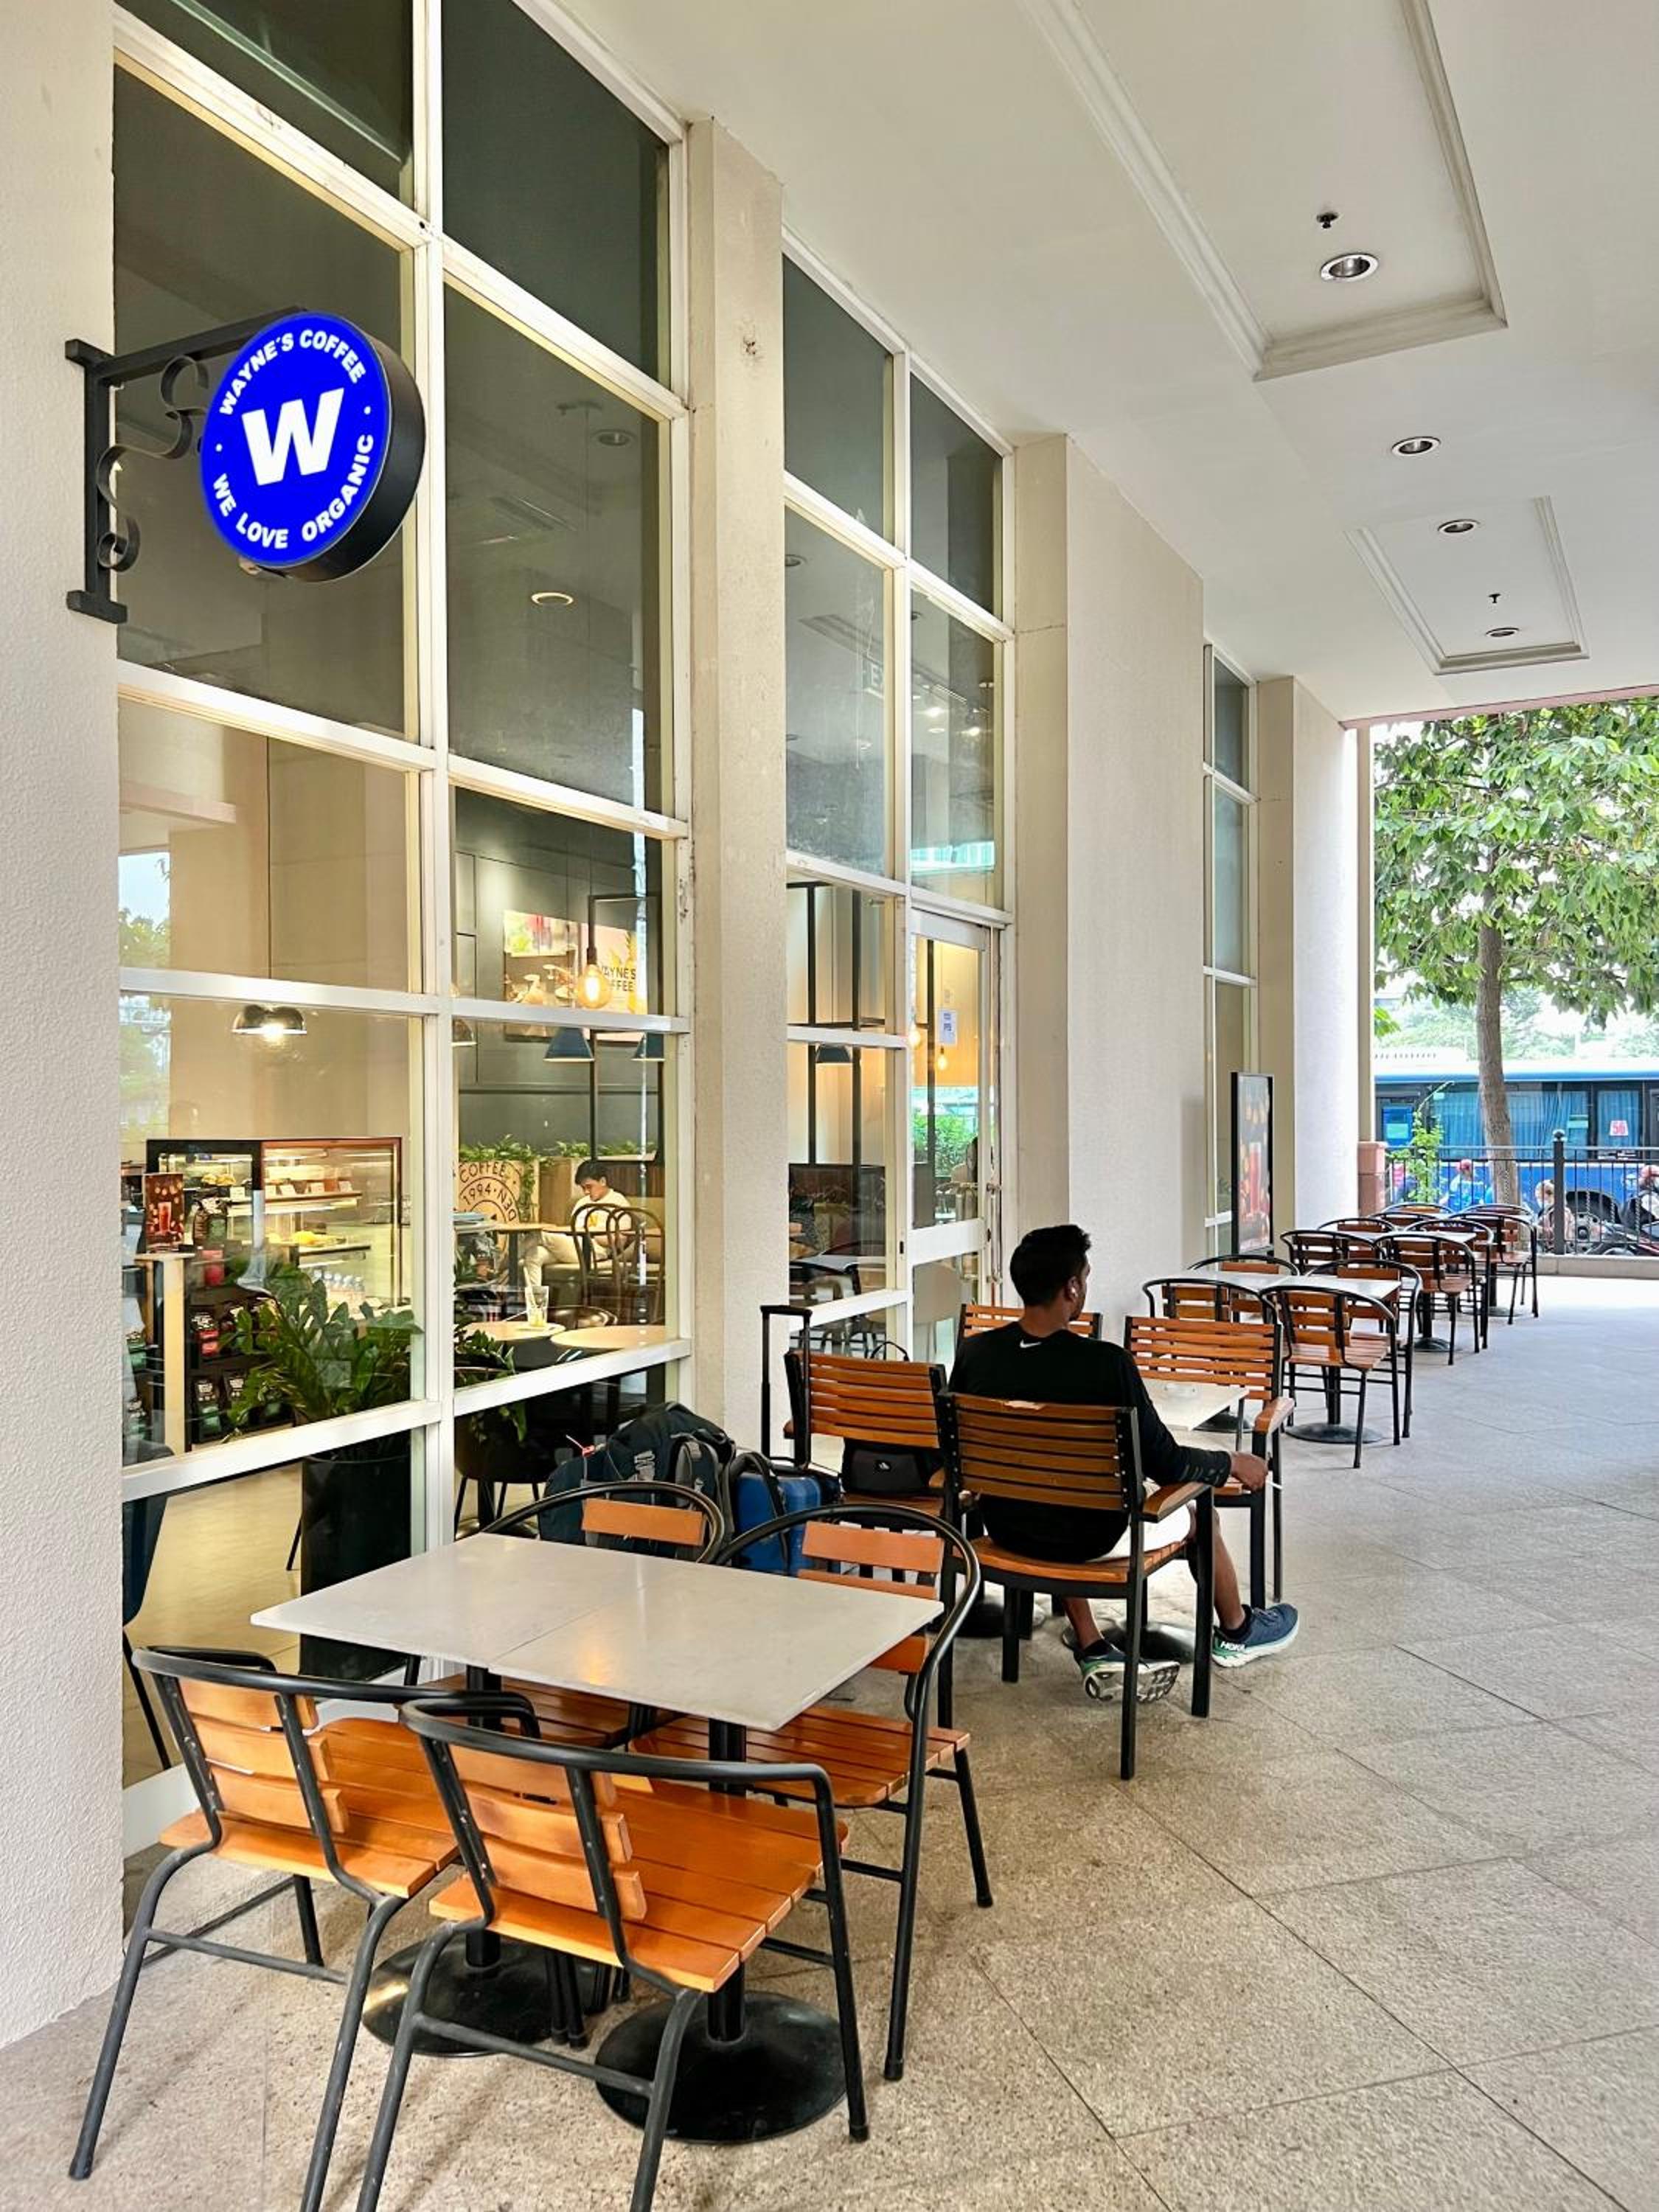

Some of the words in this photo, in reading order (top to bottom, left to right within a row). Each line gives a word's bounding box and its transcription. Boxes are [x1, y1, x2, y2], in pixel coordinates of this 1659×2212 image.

[220, 333, 293, 414] WAYNE'S
[300, 330, 366, 383] COFFEE
[241, 387, 344, 487] W
[213, 473, 237, 517] WE
[235, 512, 288, 549] LOVE
[302, 434, 374, 542] ORGANIC
[459, 1161, 505, 1183] COFFEE
[463, 1183, 492, 1206] 1994
